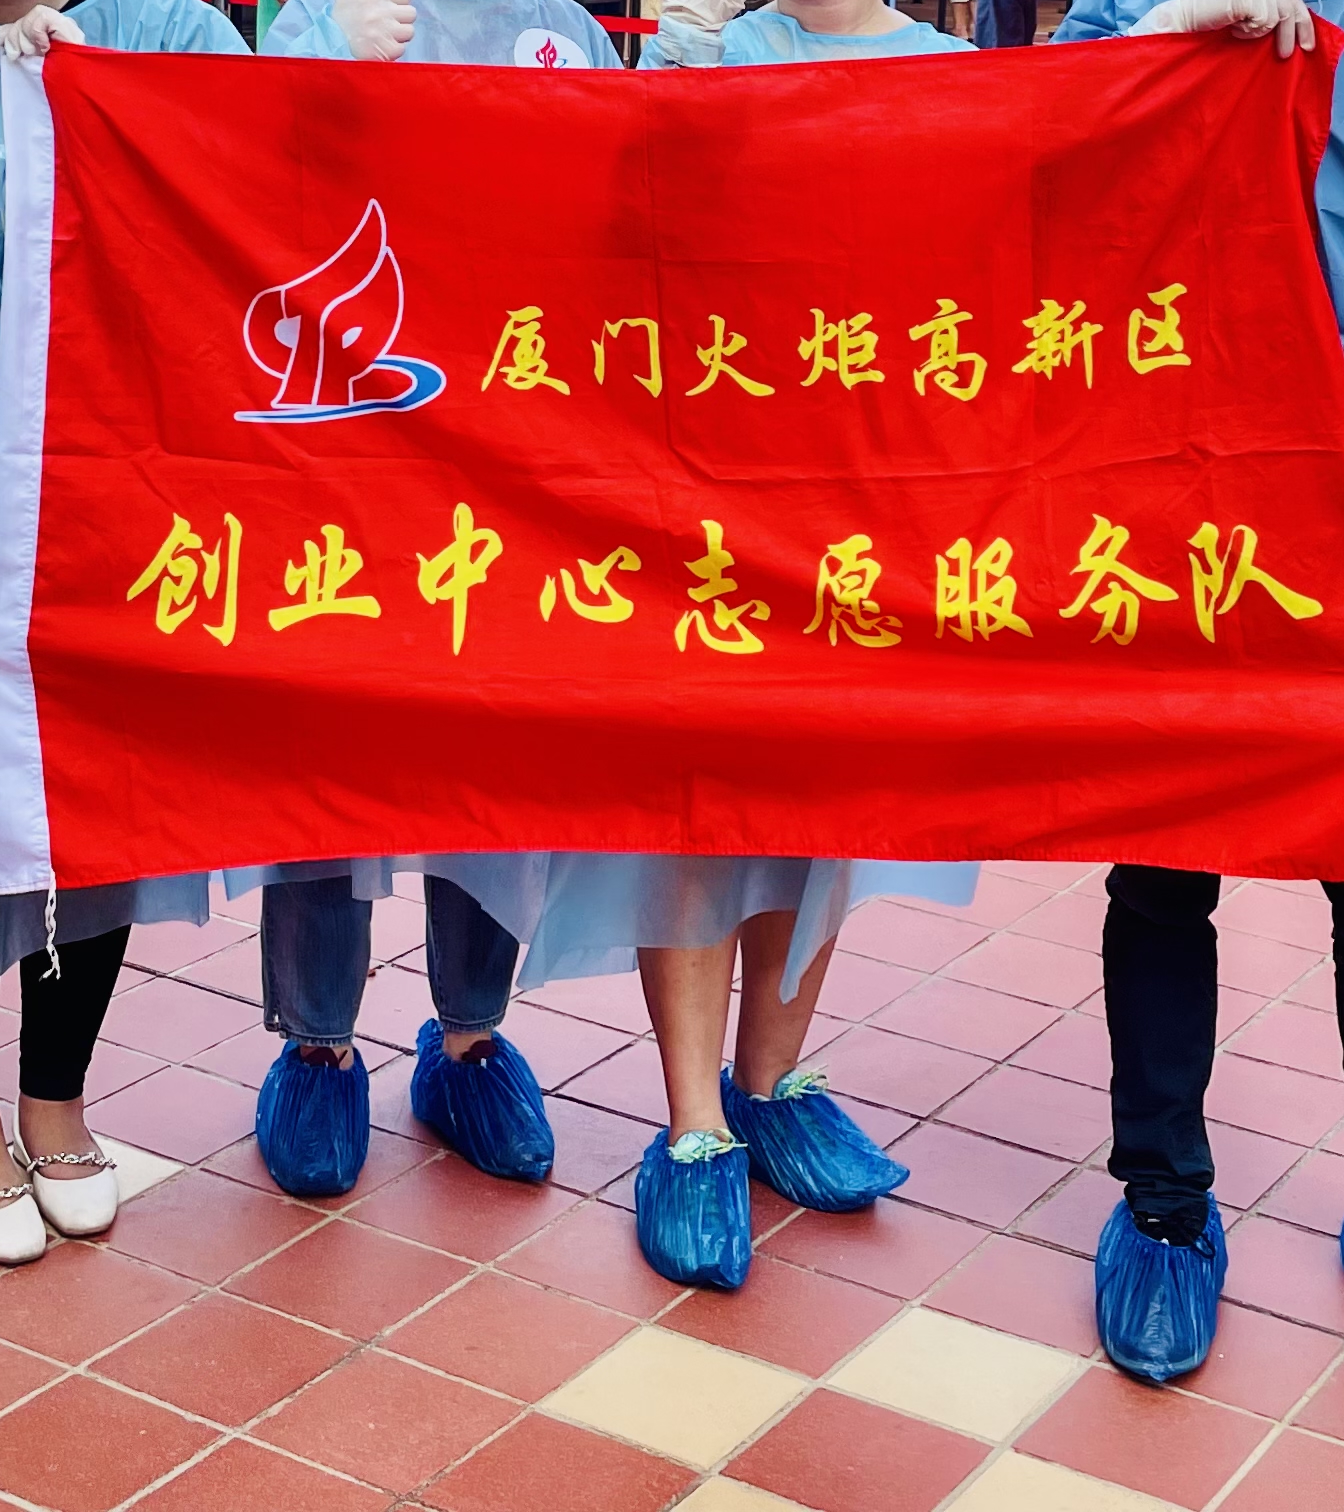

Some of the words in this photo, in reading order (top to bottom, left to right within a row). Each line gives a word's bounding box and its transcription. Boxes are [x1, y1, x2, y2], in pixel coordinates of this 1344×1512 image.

[480, 282, 1192, 402] 厦门火炬高新区
[126, 502, 1323, 654] 创业中心志愿服务队
